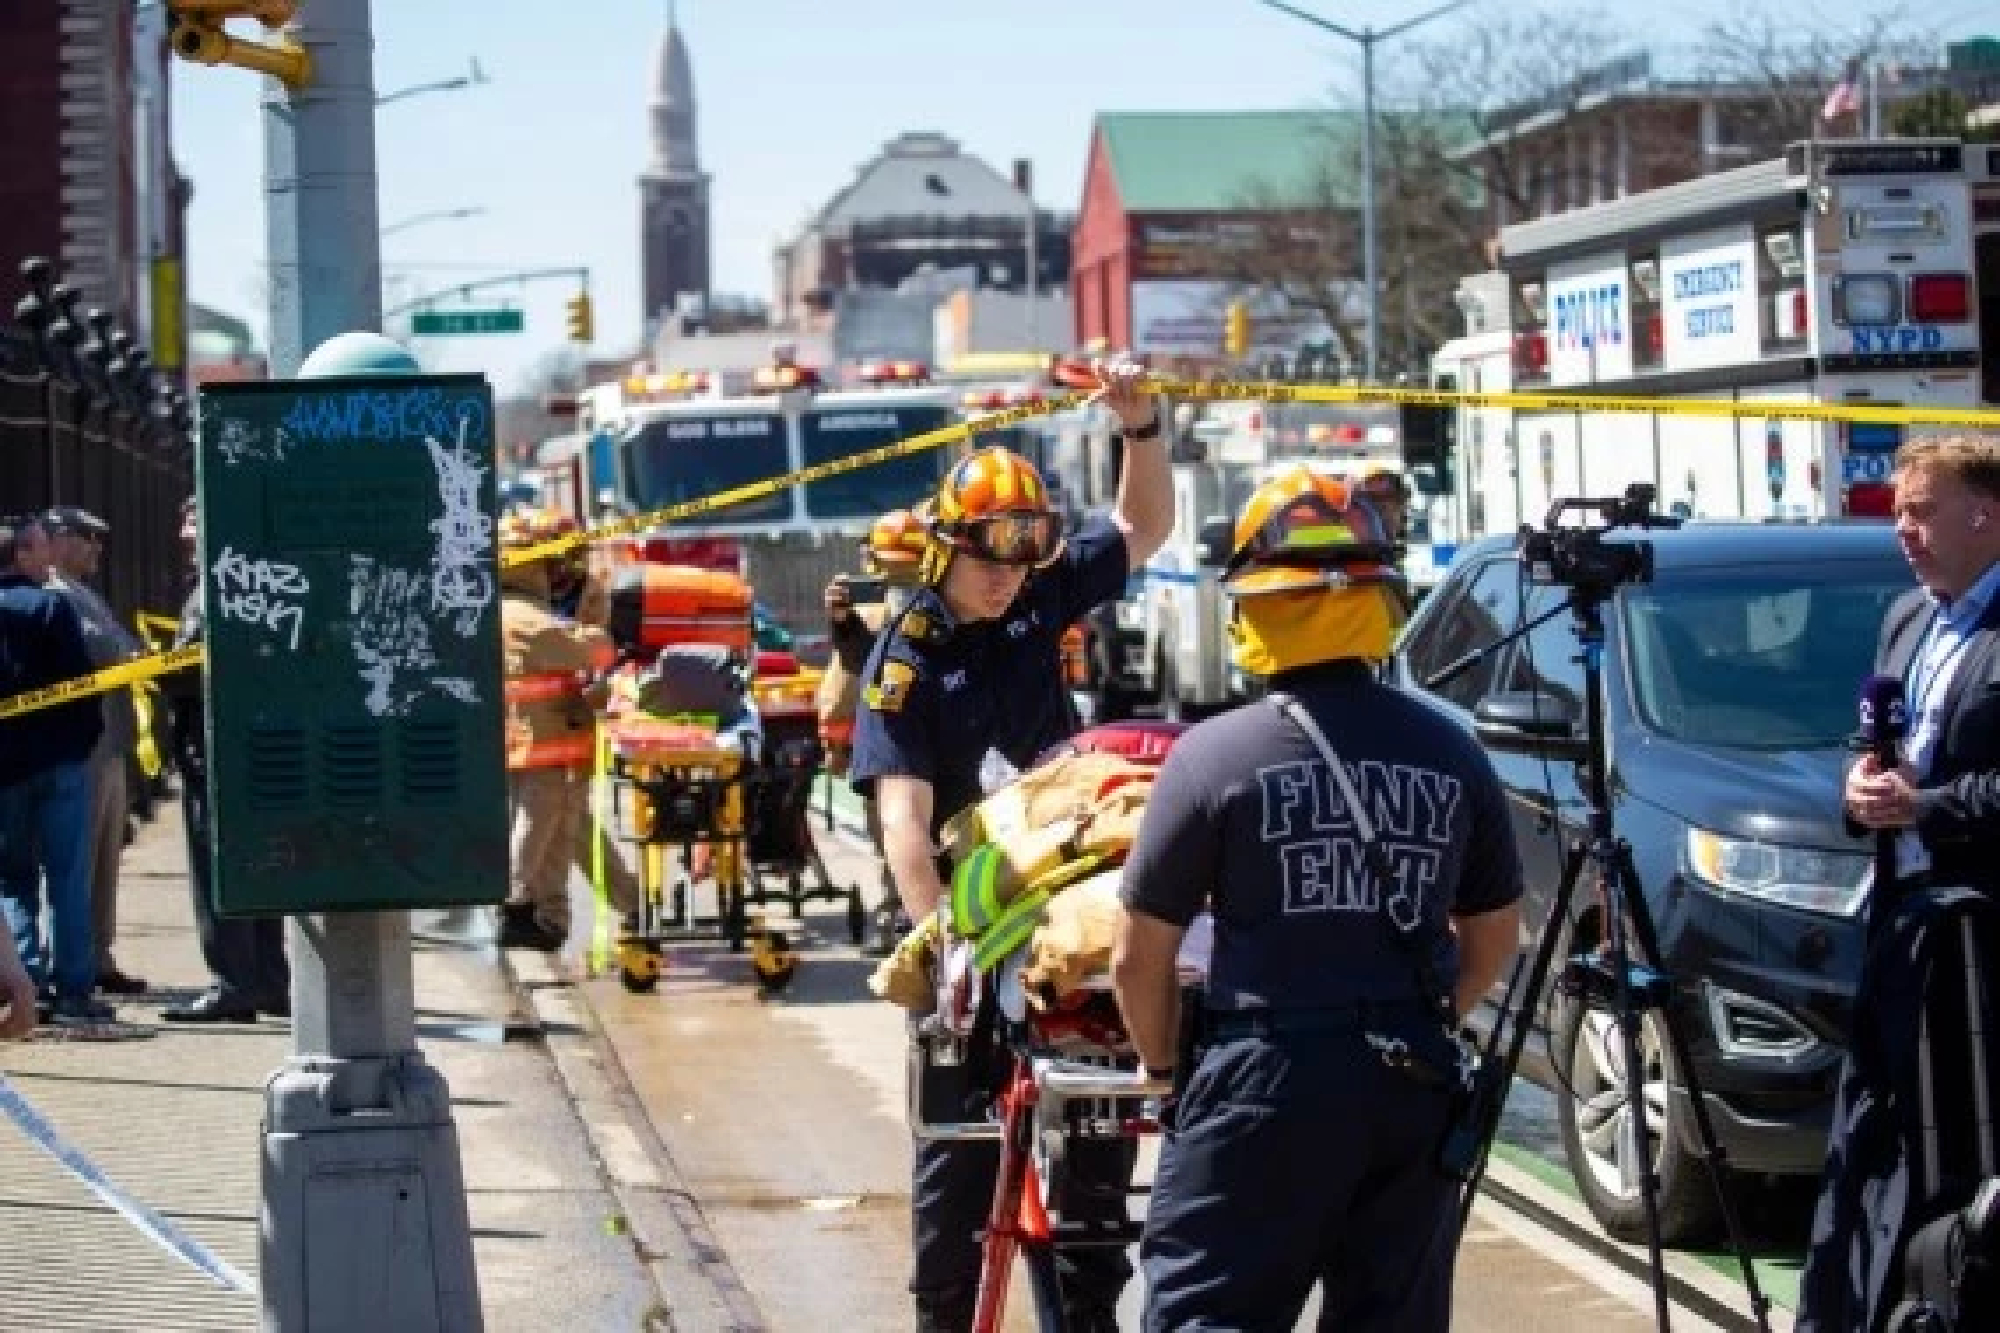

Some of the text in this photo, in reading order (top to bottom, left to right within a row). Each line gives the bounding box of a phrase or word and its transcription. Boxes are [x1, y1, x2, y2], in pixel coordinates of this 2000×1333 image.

[1556, 283, 1622, 351] POLICE
[1853, 326, 1945, 351] NYPD
[1281, 838, 1442, 930] EMT
